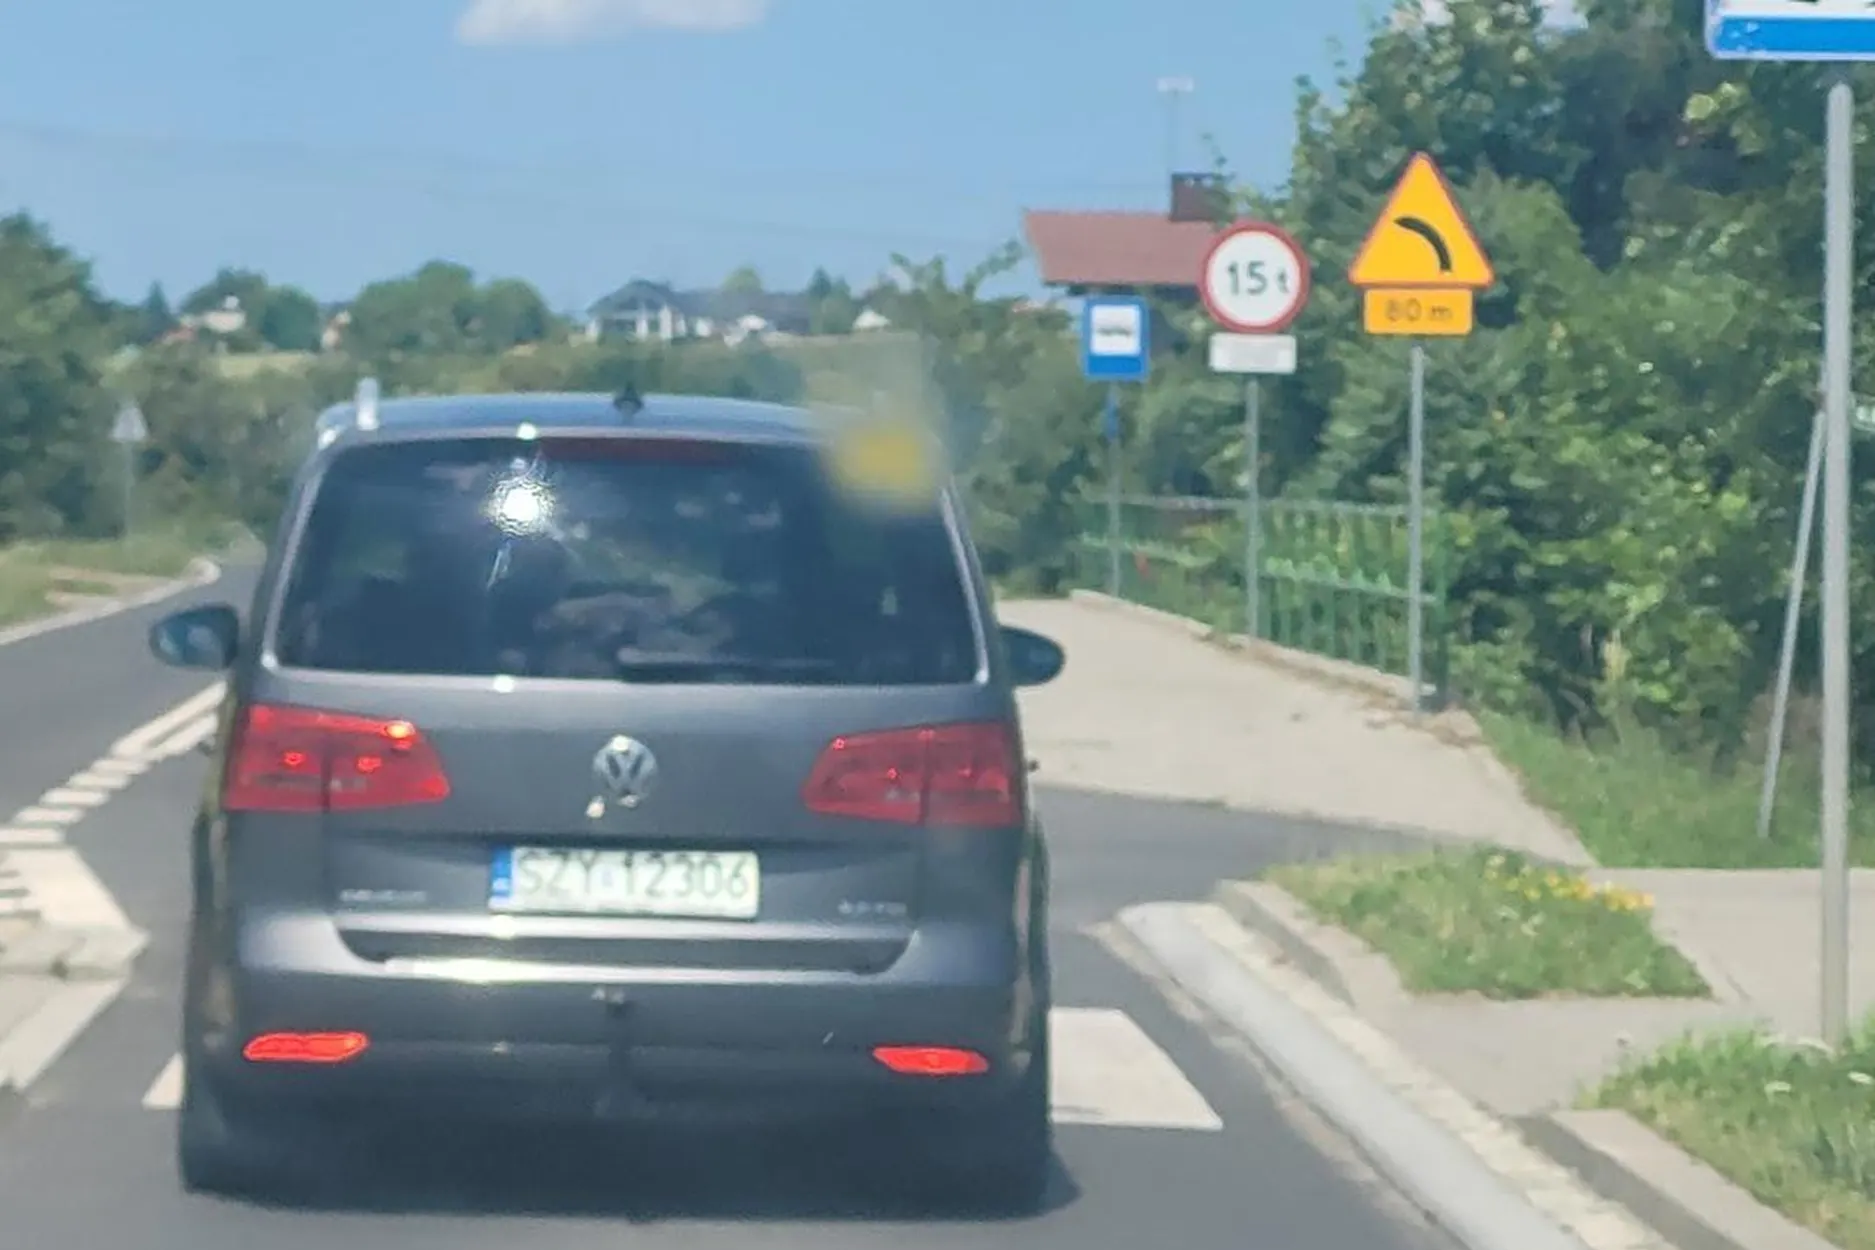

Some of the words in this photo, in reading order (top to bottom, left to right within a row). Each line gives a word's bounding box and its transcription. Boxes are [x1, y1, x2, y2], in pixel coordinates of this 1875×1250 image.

[1227, 260, 1269, 295] 15
[1428, 304, 1453, 321] m
[517, 850, 599, 896] SZY
[623, 851, 751, 899] 12306
